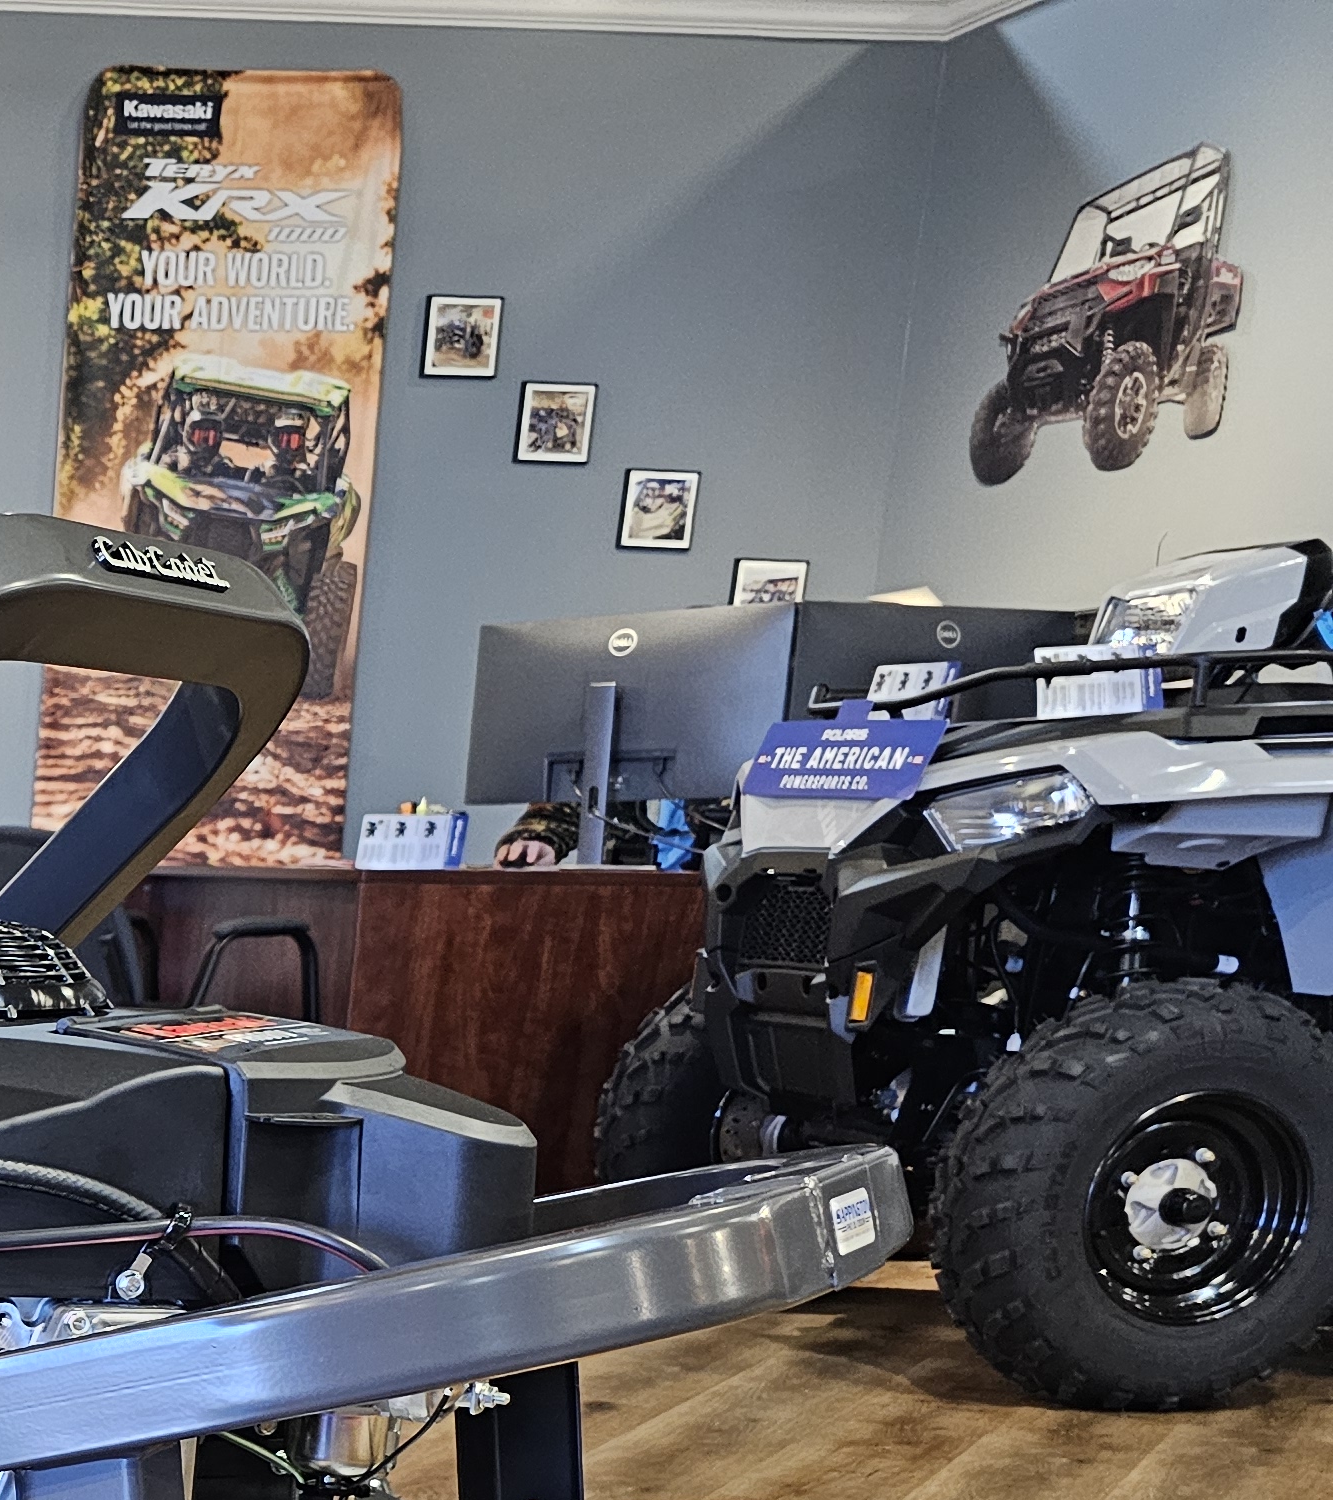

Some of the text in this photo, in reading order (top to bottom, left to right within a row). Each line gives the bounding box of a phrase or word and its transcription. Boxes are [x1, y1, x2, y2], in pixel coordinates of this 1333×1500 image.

[123, 100, 214, 119] Kawasaki
[121, 181, 355, 222] KRX
[266, 226, 348, 243] 1000
[141, 250, 330, 289] YOUR WORLD.
[107, 292, 355, 332] YOUR ADVENTURE.
[92, 536, 231, 588] Cub Cadet
[821, 728, 869, 741] POLARIS
[770, 746, 910, 770] THE AMERICAN
[779, 774, 868, 790] POWERSPORTS CO.
